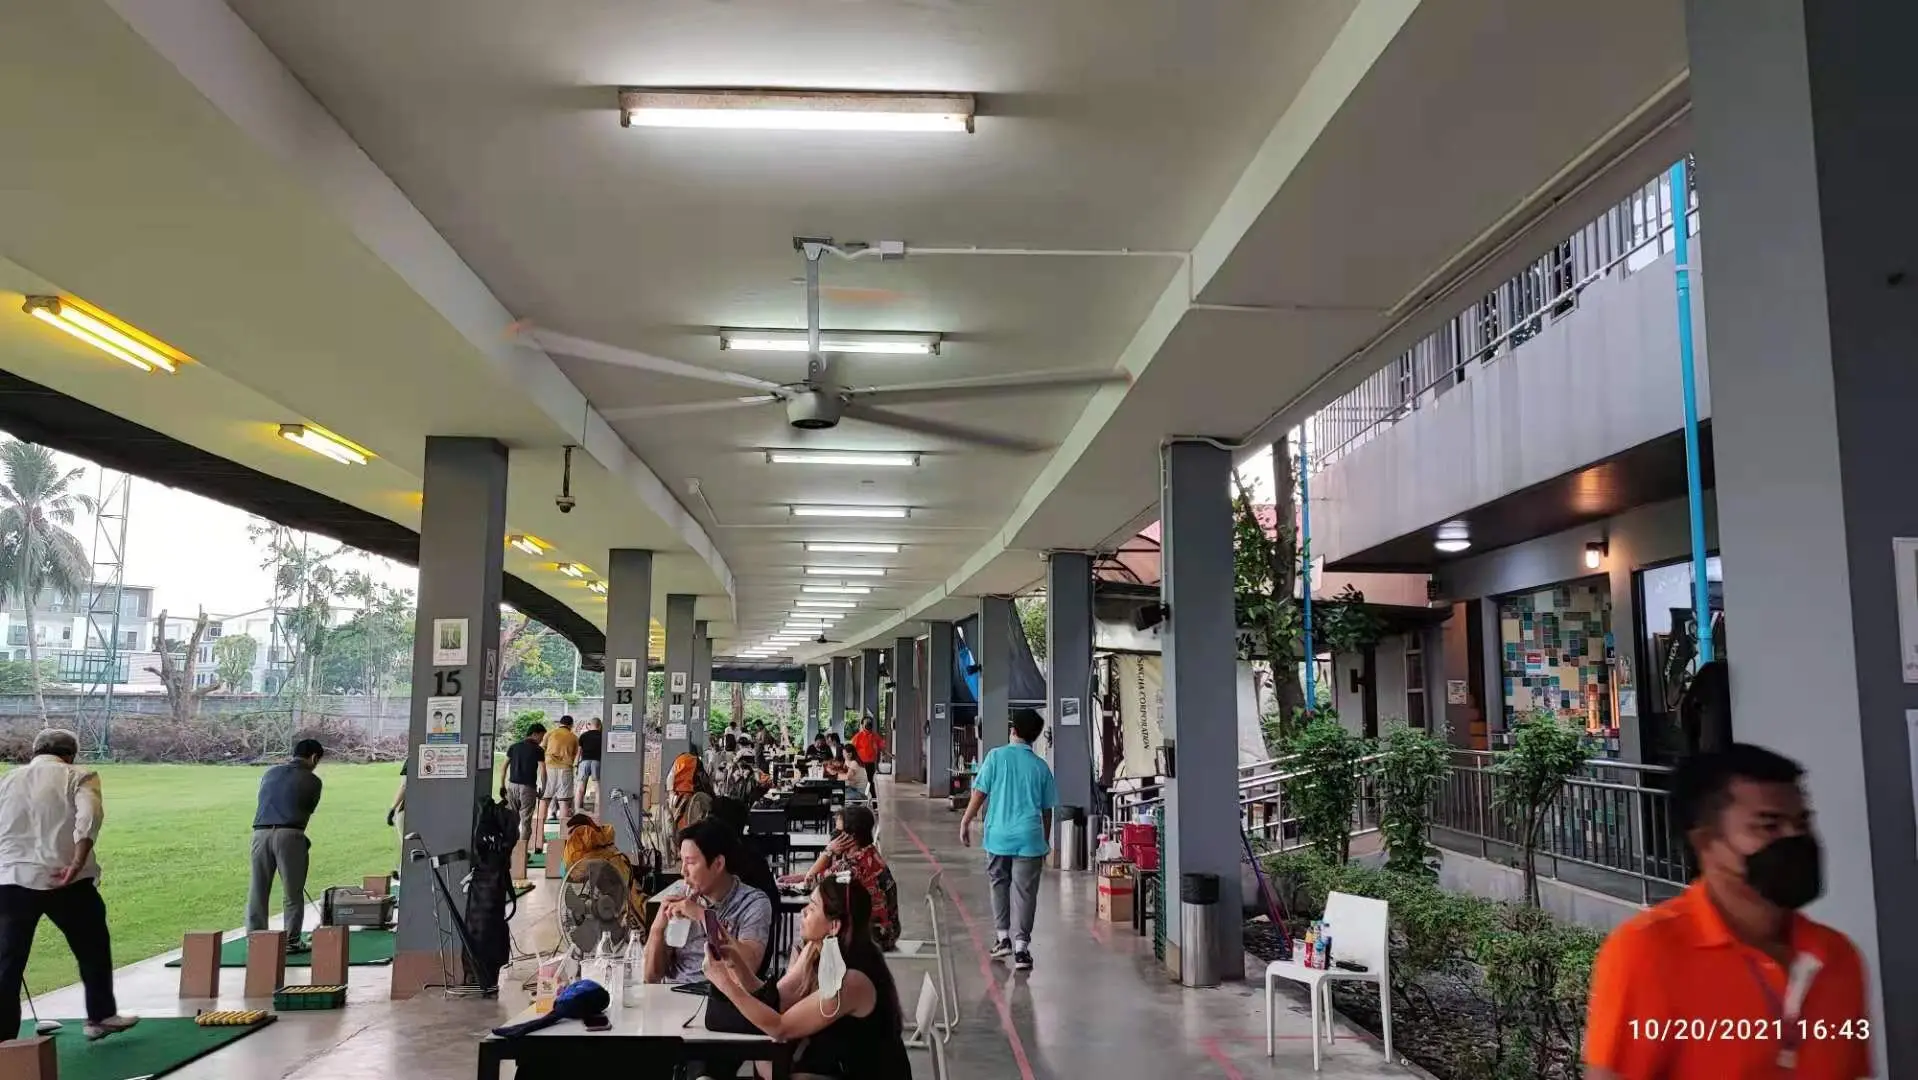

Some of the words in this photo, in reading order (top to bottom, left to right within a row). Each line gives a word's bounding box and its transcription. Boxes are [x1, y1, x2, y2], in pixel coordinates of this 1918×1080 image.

[434, 669, 462, 697] 15
[1136, 655, 1145, 690] SINGHA
[616, 689, 633, 705] 13
[672, 694, 682, 705] 11
[1138, 690, 1151, 750] CORPORATION
